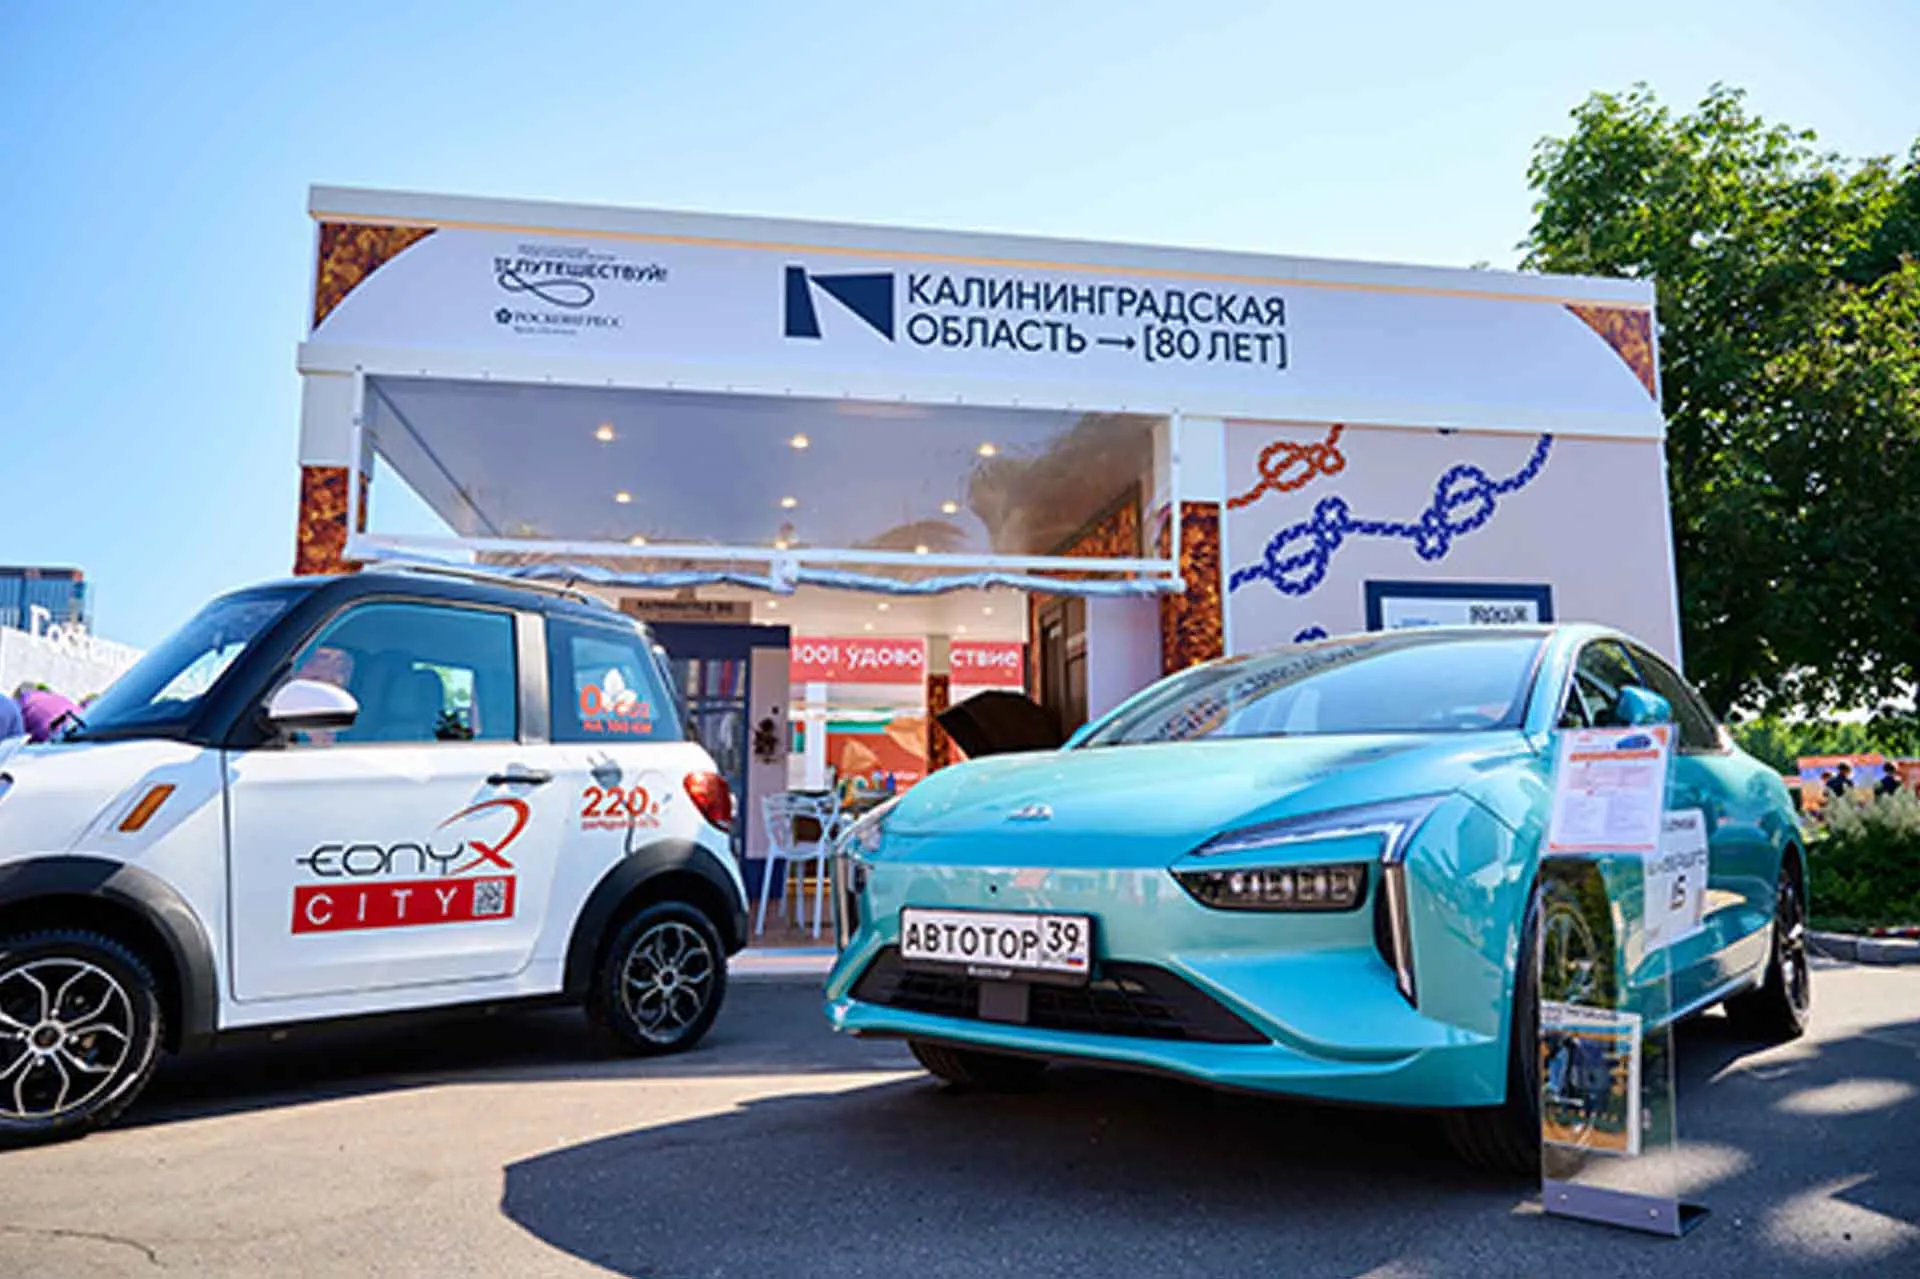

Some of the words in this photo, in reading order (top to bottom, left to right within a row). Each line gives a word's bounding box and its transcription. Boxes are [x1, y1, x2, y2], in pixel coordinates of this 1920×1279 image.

[908, 273, 1286, 327] КАЛИНИНГРАДСКАЯ
[906, 312, 1088, 354] ОБЛАСТЬ
[581, 786, 649, 817] 220
[305, 886, 458, 925] CITY
[906, 922, 1040, 959] АВТОТОР
[1047, 921, 1080, 953] 39
